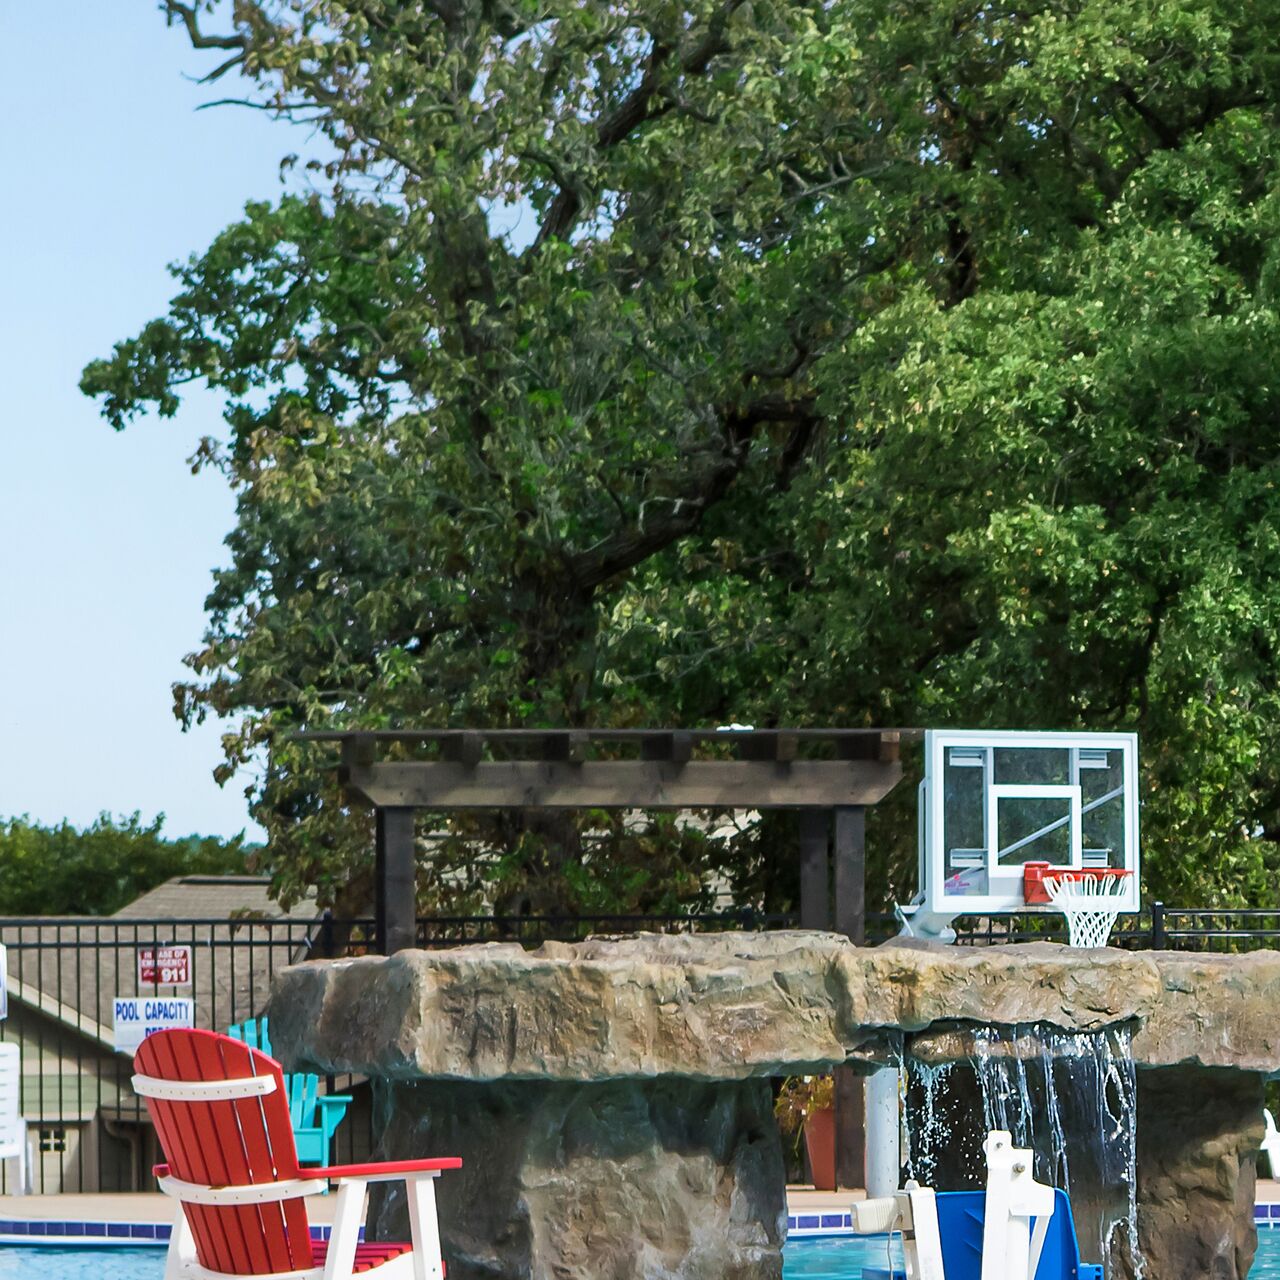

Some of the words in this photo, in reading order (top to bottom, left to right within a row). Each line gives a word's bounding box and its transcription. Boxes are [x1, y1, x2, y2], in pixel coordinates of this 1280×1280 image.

[161, 968, 185, 982] 911
[116, 1002, 140, 1021] POOL
[145, 1002, 189, 1020] CAPACITY
